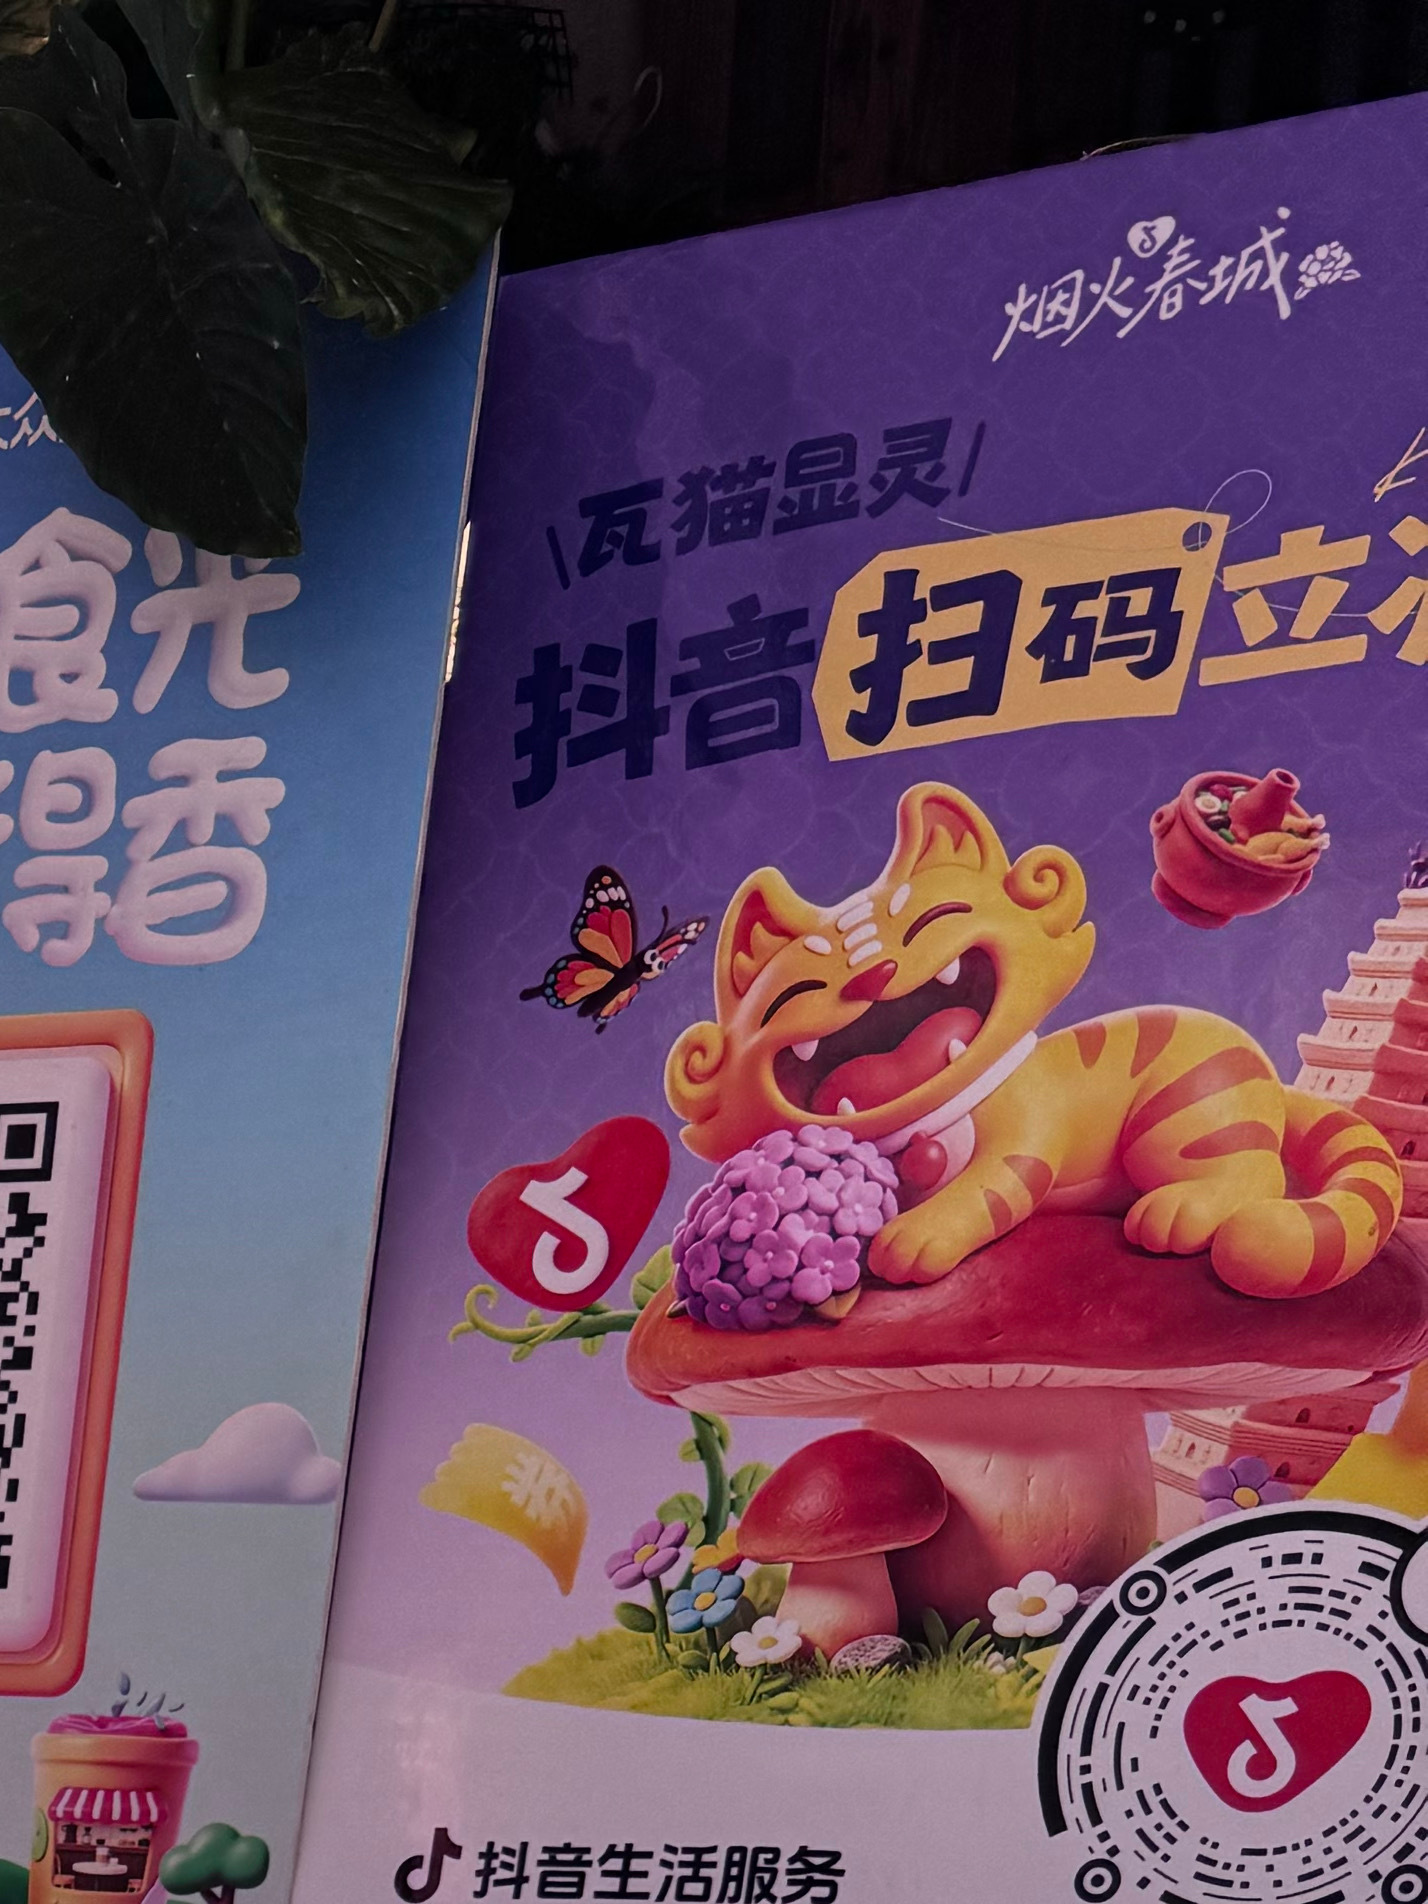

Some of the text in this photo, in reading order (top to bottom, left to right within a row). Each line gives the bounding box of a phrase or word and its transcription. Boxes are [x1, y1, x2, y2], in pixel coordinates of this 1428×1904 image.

[991, 206, 1292, 363] 烟火春城
[574, 417, 955, 578] 瓦猫显灵
